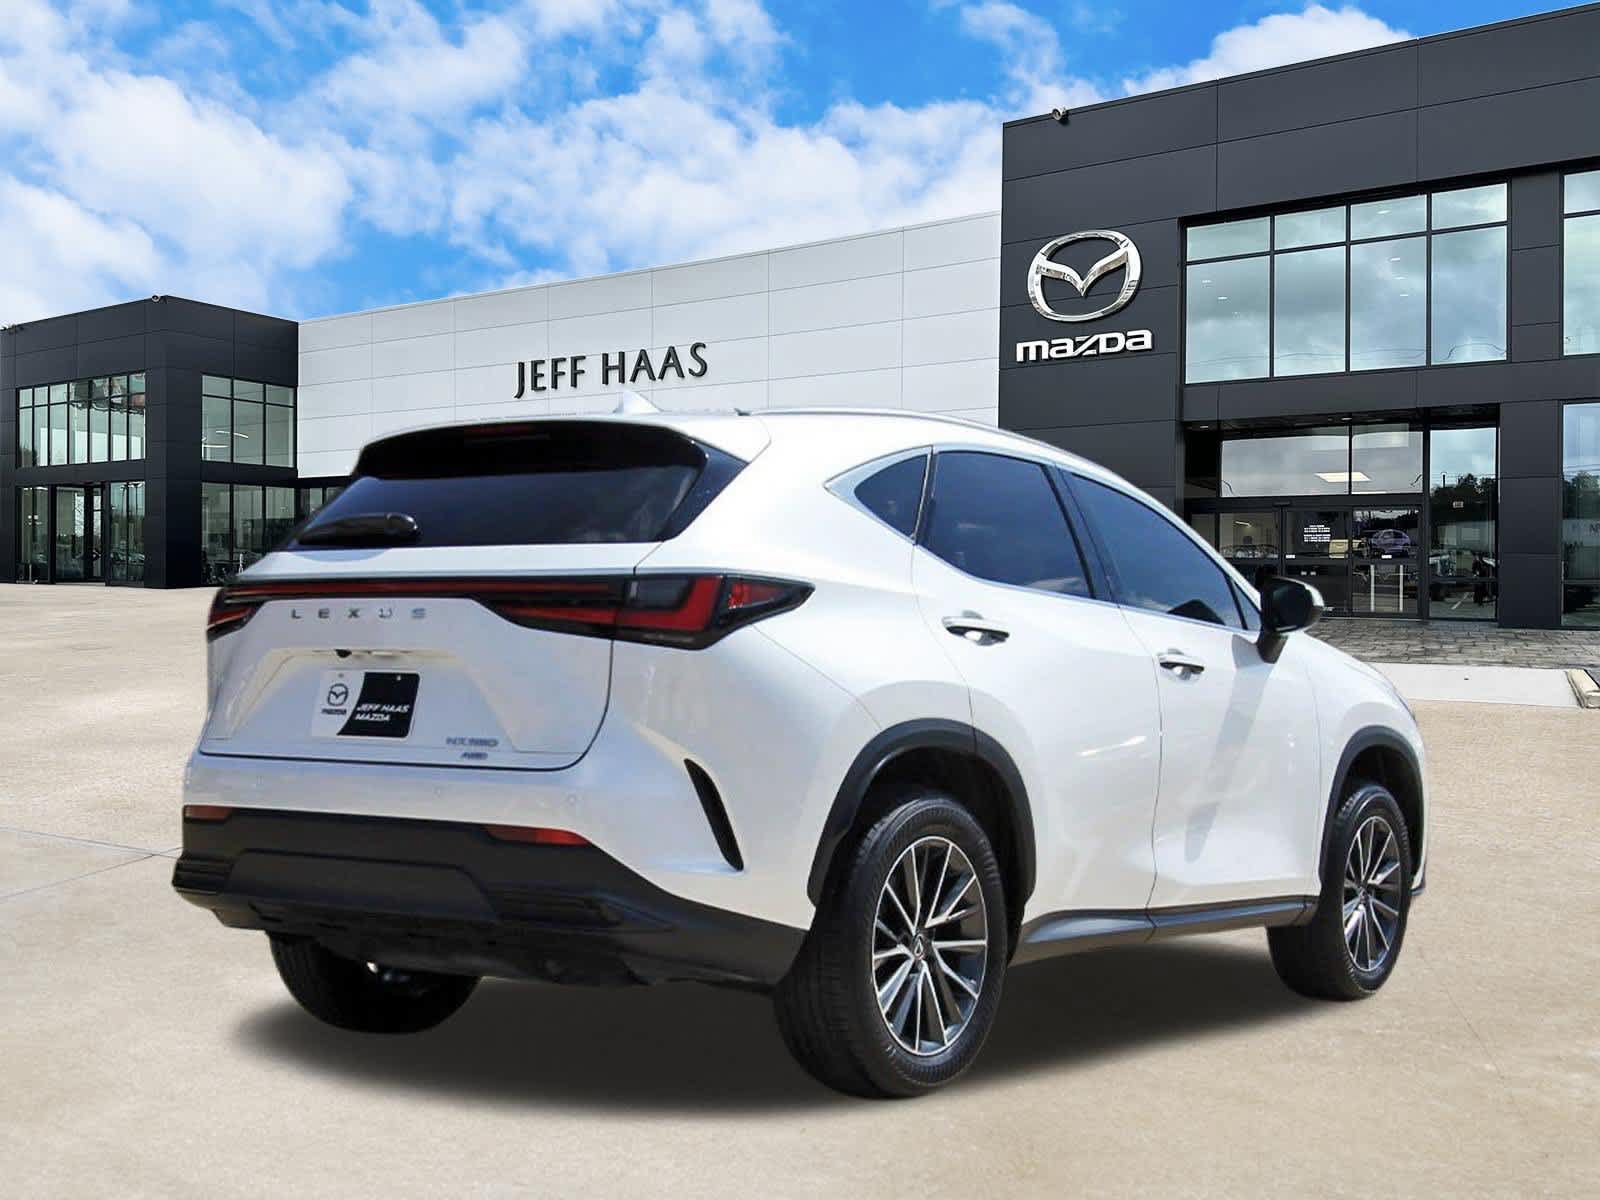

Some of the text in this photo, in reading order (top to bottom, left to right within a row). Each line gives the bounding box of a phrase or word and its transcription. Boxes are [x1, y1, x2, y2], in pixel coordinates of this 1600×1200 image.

[514, 342, 708, 399] JEFF HAAS
[291, 607, 427, 619] LEXUS
[357, 703, 410, 713] JEFF HAAS
[355, 713, 390, 721] MAZDA
